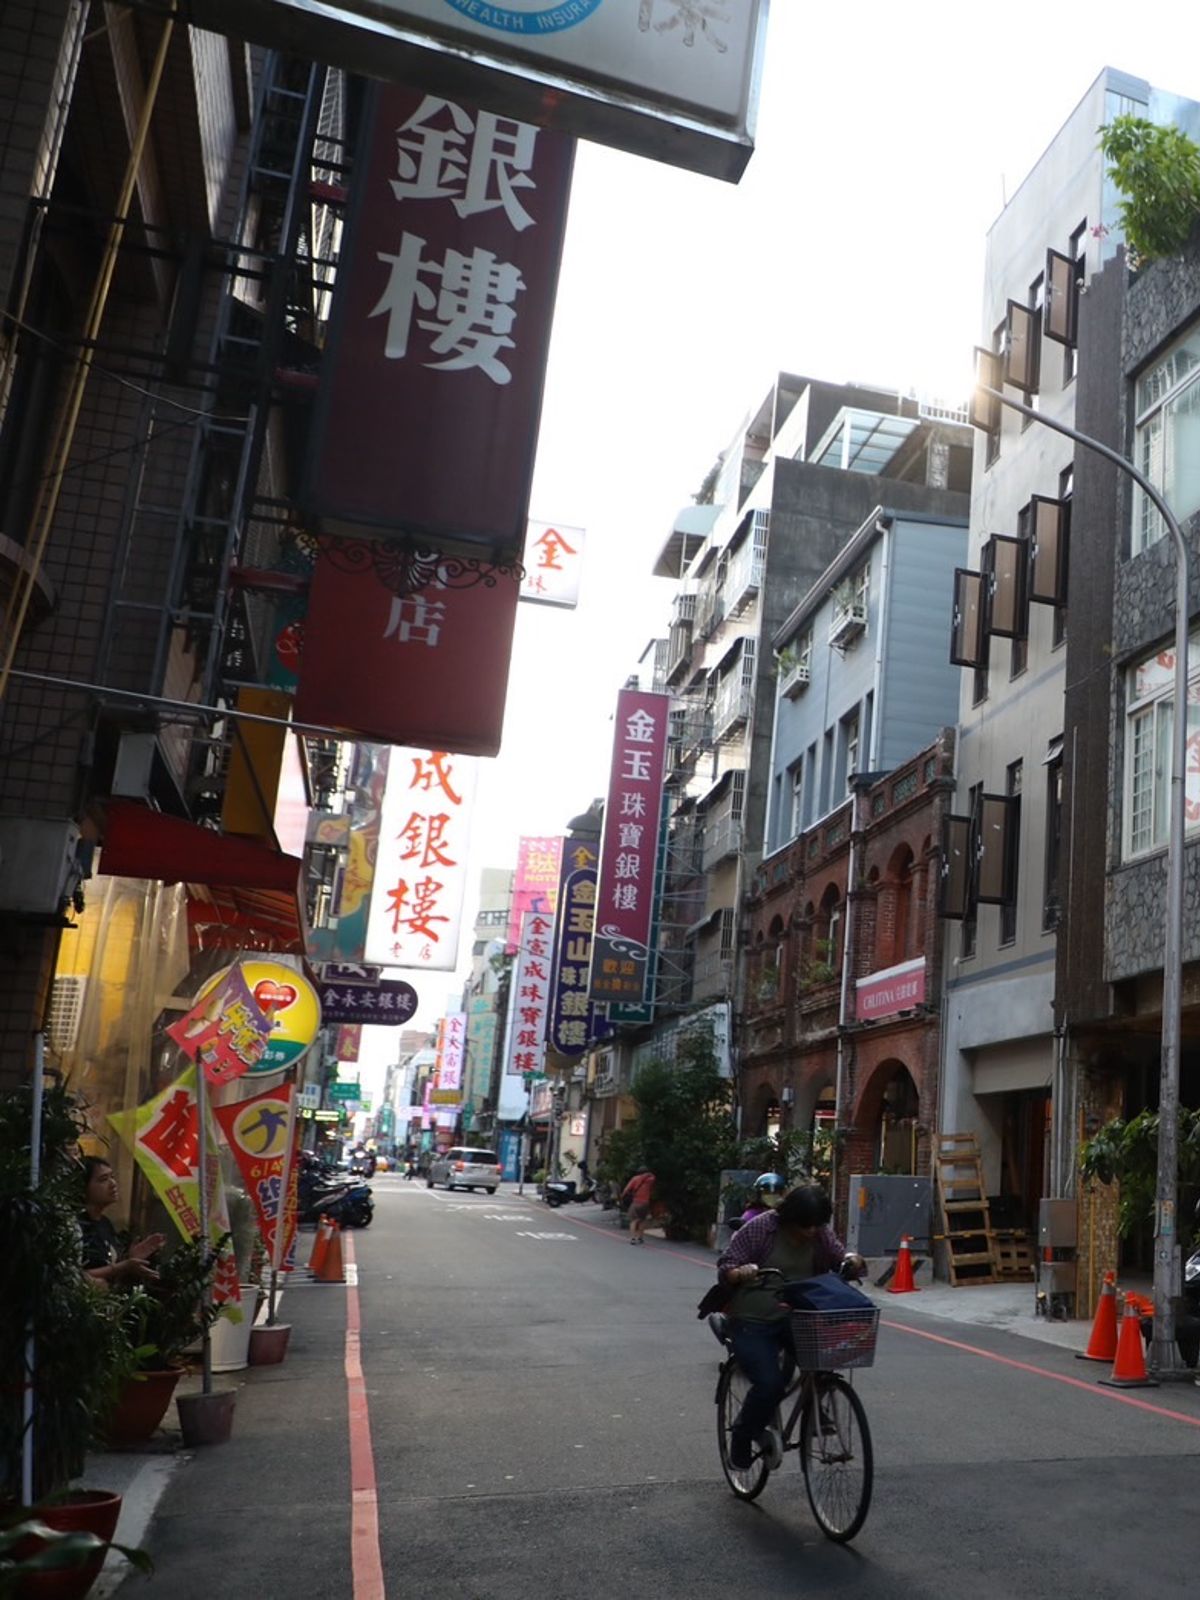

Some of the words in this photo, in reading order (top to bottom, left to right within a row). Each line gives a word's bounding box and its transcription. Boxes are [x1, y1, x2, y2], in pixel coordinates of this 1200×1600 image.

[368, 94, 541, 386] 銀樓
[533, 528, 577, 570] 金
[611, 708, 656, 912] 金玉珠寶銀樓
